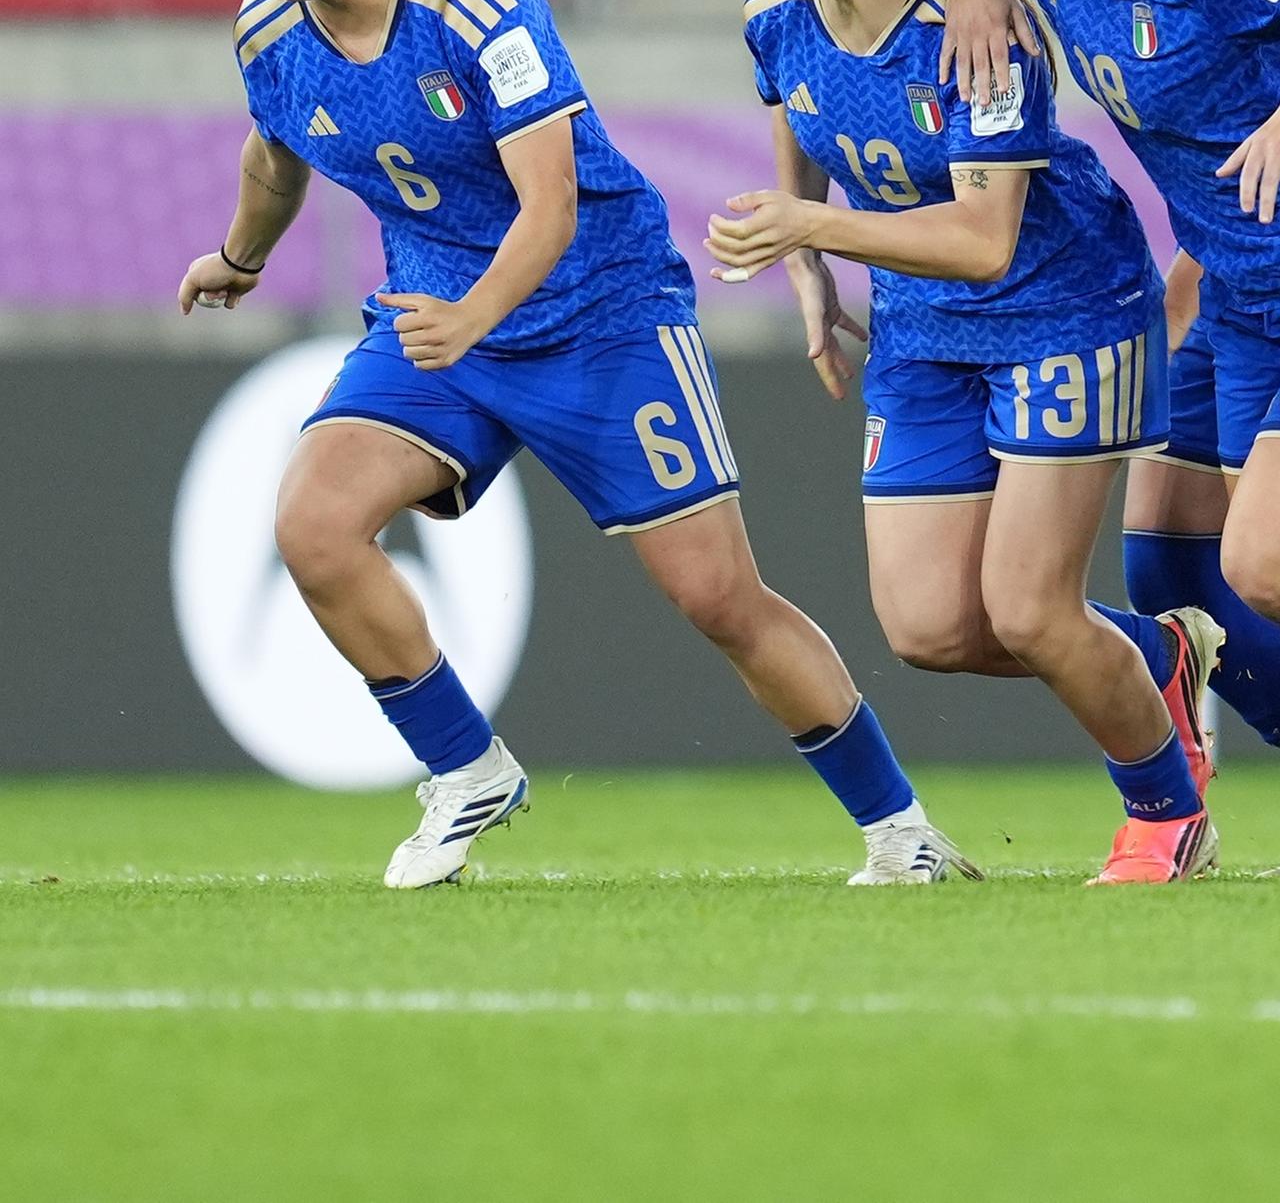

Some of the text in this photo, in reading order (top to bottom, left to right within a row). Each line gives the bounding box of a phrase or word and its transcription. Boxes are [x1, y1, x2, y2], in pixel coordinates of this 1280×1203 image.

[491, 41, 525, 65] FOOTBALL
[497, 49, 530, 75] UNITES
[420, 72, 451, 90] ITALIA
[909, 87, 934, 99] ITALIA
[1073, 44, 1141, 131] 18
[991, 86, 1016, 103] NITES
[376, 141, 441, 211] 6
[835, 133, 921, 206] 13
[1010, 353, 1090, 440] 13
[633, 400, 697, 490] 6
[1124, 797, 1174, 812] TALIA
